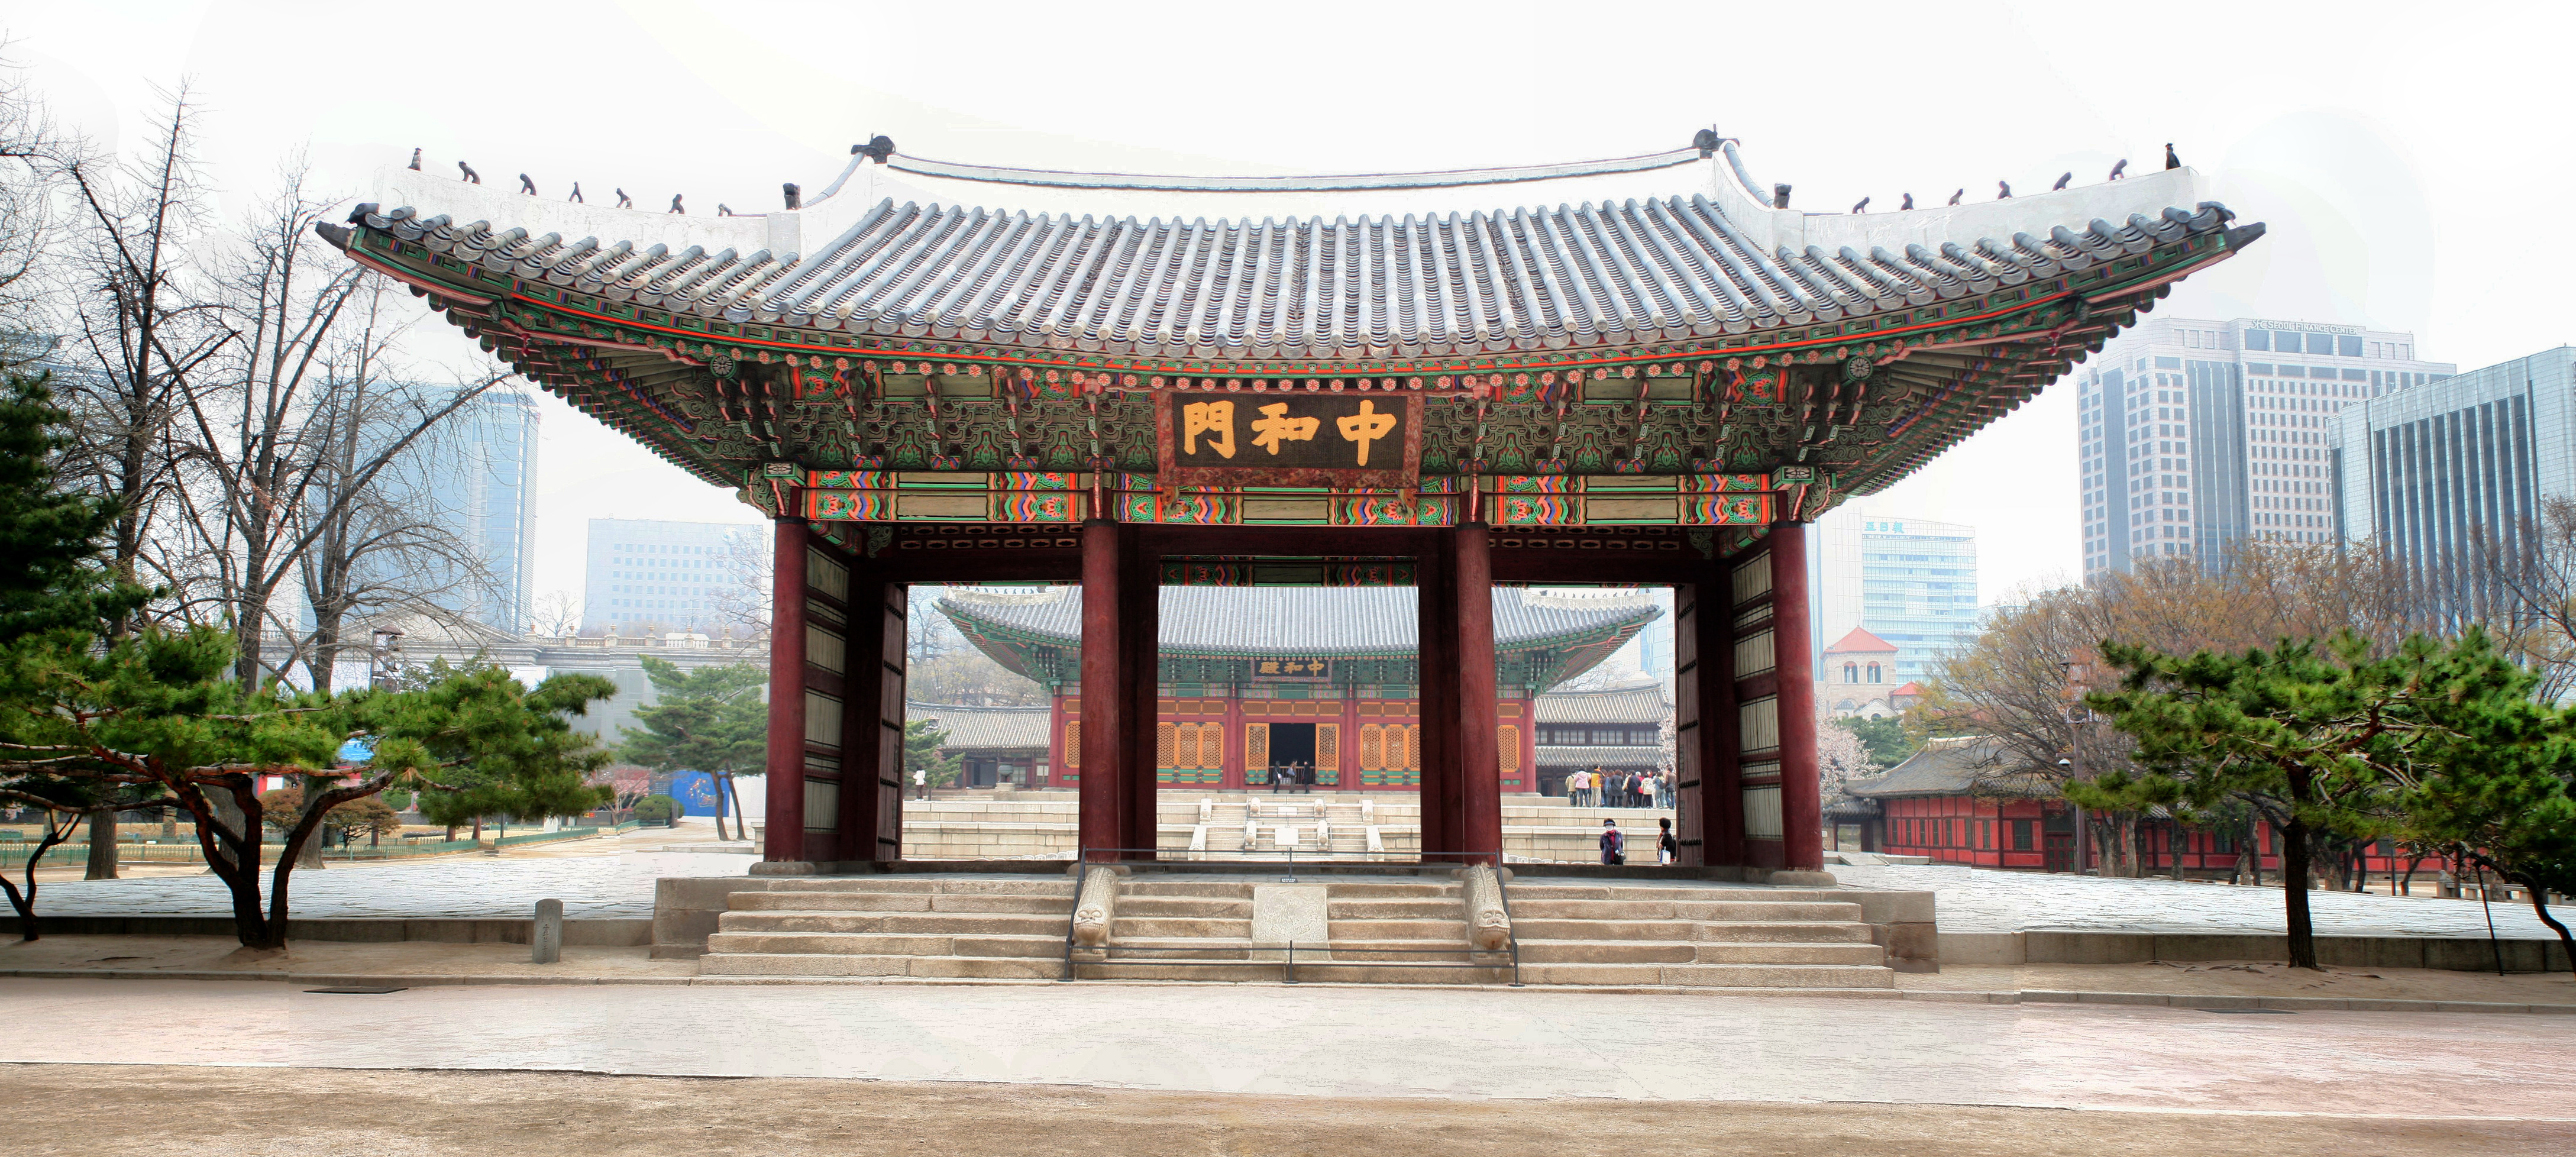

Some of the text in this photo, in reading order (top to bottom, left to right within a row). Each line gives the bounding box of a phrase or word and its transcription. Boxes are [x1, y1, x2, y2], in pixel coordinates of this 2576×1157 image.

[2268, 320, 2294, 331] SEOUL
[2295, 322, 2329, 332] FINANCE
[2329, 325, 2358, 335] CENTER
[1183, 400, 1397, 466] 中和門
